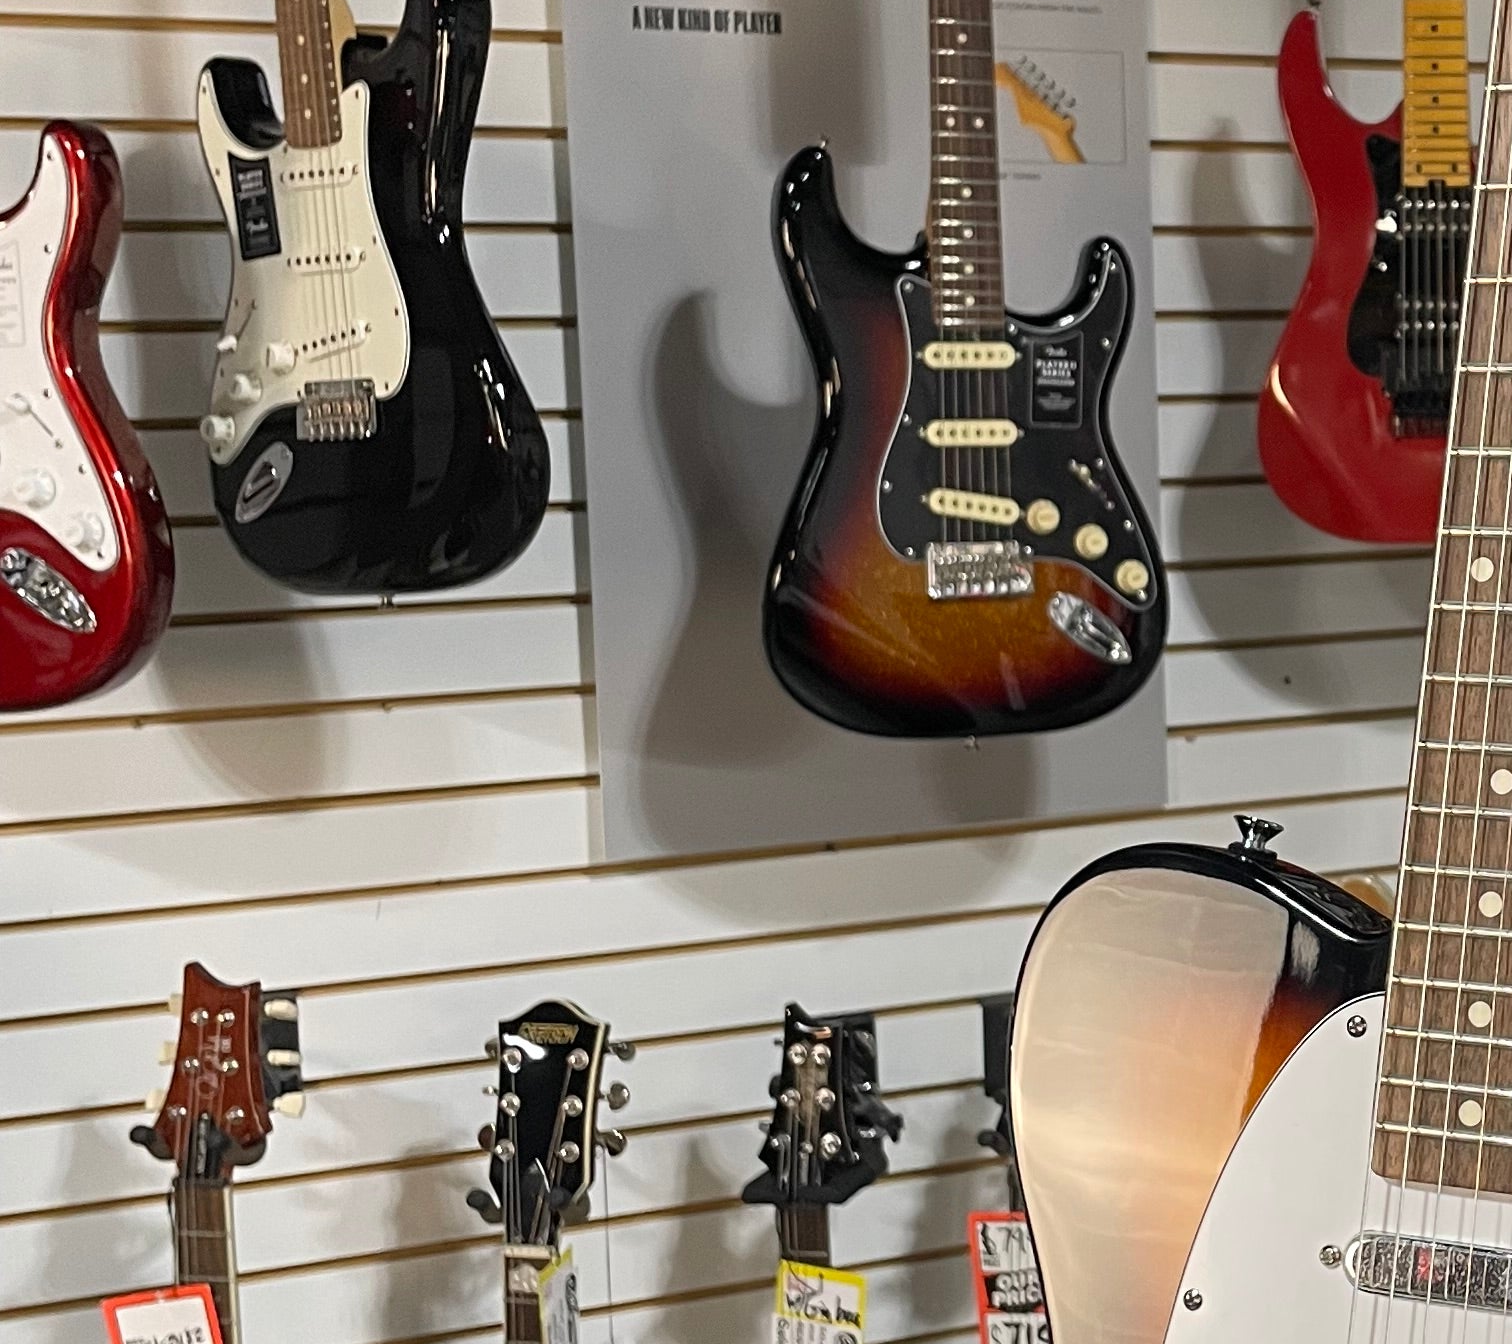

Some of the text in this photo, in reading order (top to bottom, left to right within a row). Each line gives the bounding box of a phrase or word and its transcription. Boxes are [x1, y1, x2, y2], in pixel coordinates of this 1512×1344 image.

[632, 6, 782, 35] A NEW KIND OF PLAYER
[981, 1223, 1032, 1255] $79
[991, 1284, 1044, 1309] PRIC
